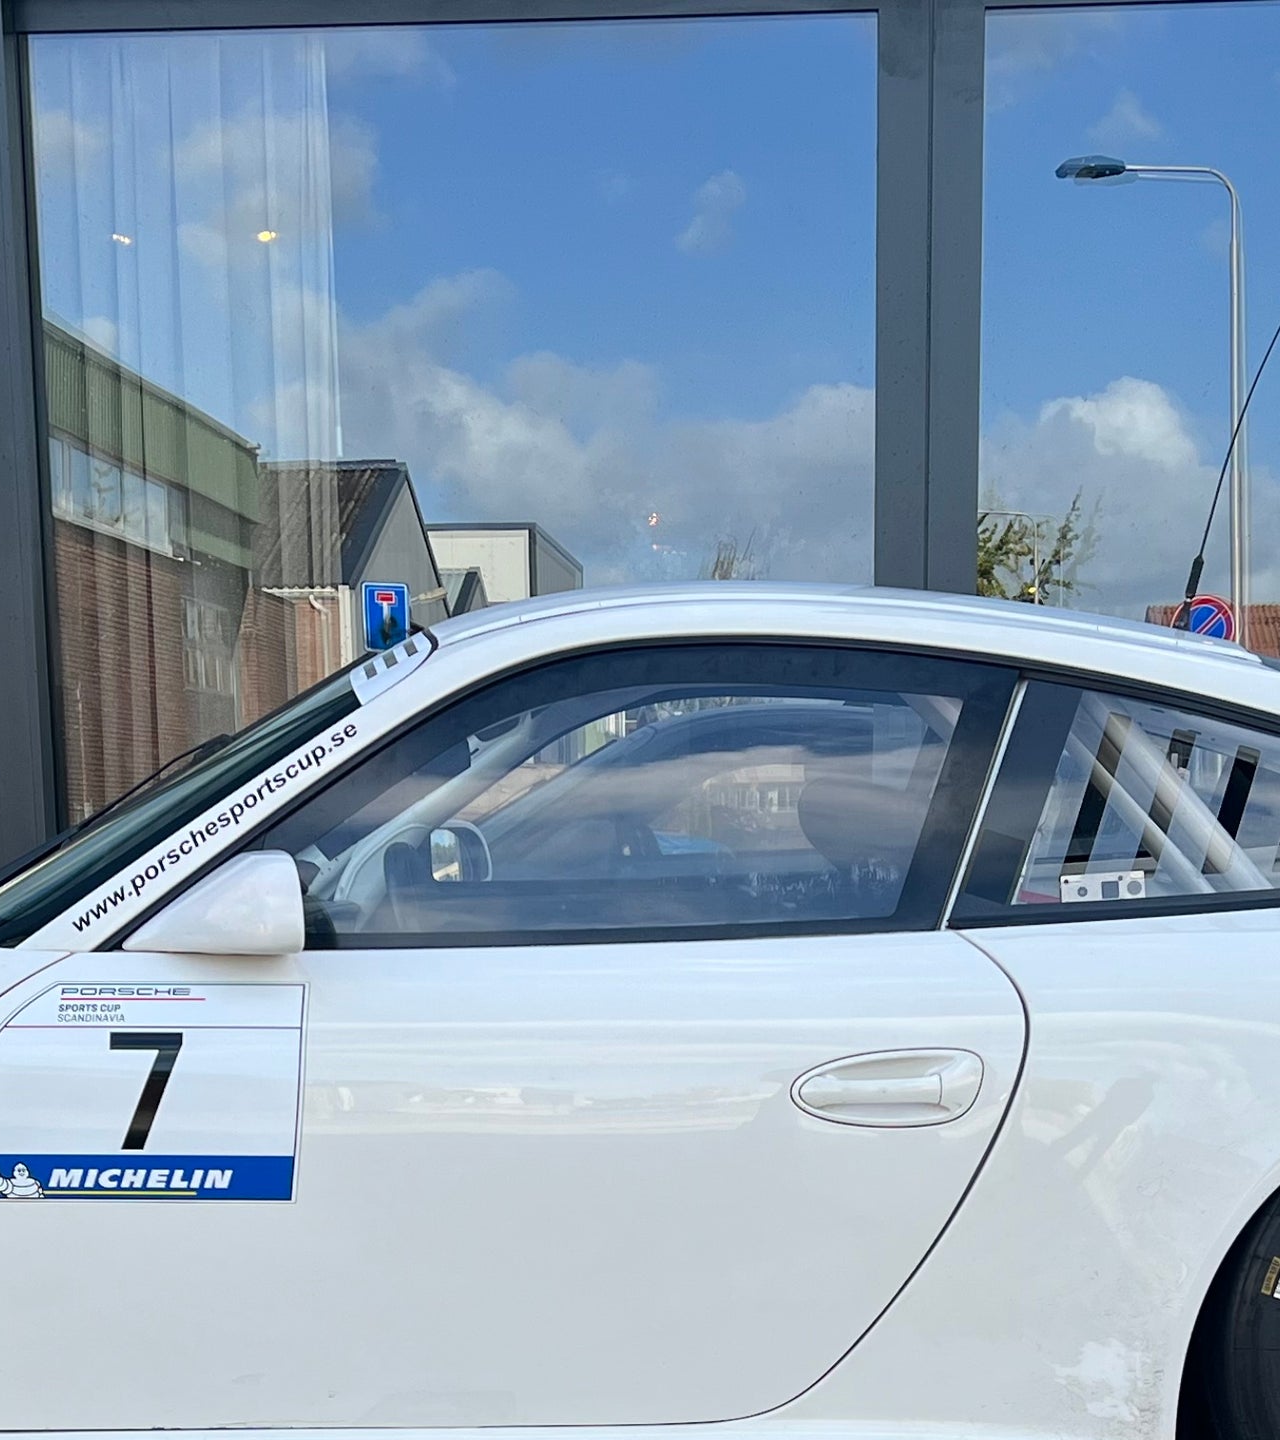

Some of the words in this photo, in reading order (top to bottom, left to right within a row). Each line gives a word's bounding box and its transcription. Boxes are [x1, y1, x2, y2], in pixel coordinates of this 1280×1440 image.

[72, 722, 358, 932] www.porschesportscup.se
[60, 987, 191, 996] PORSCHE
[58, 1004, 98, 1012] SPORTS
[100, 1004, 121, 1012] CUP
[57, 1013, 125, 1023] SCANDINAVIA
[109, 1031, 183, 1150] 7
[48, 1168, 233, 1189] MICHELIN
